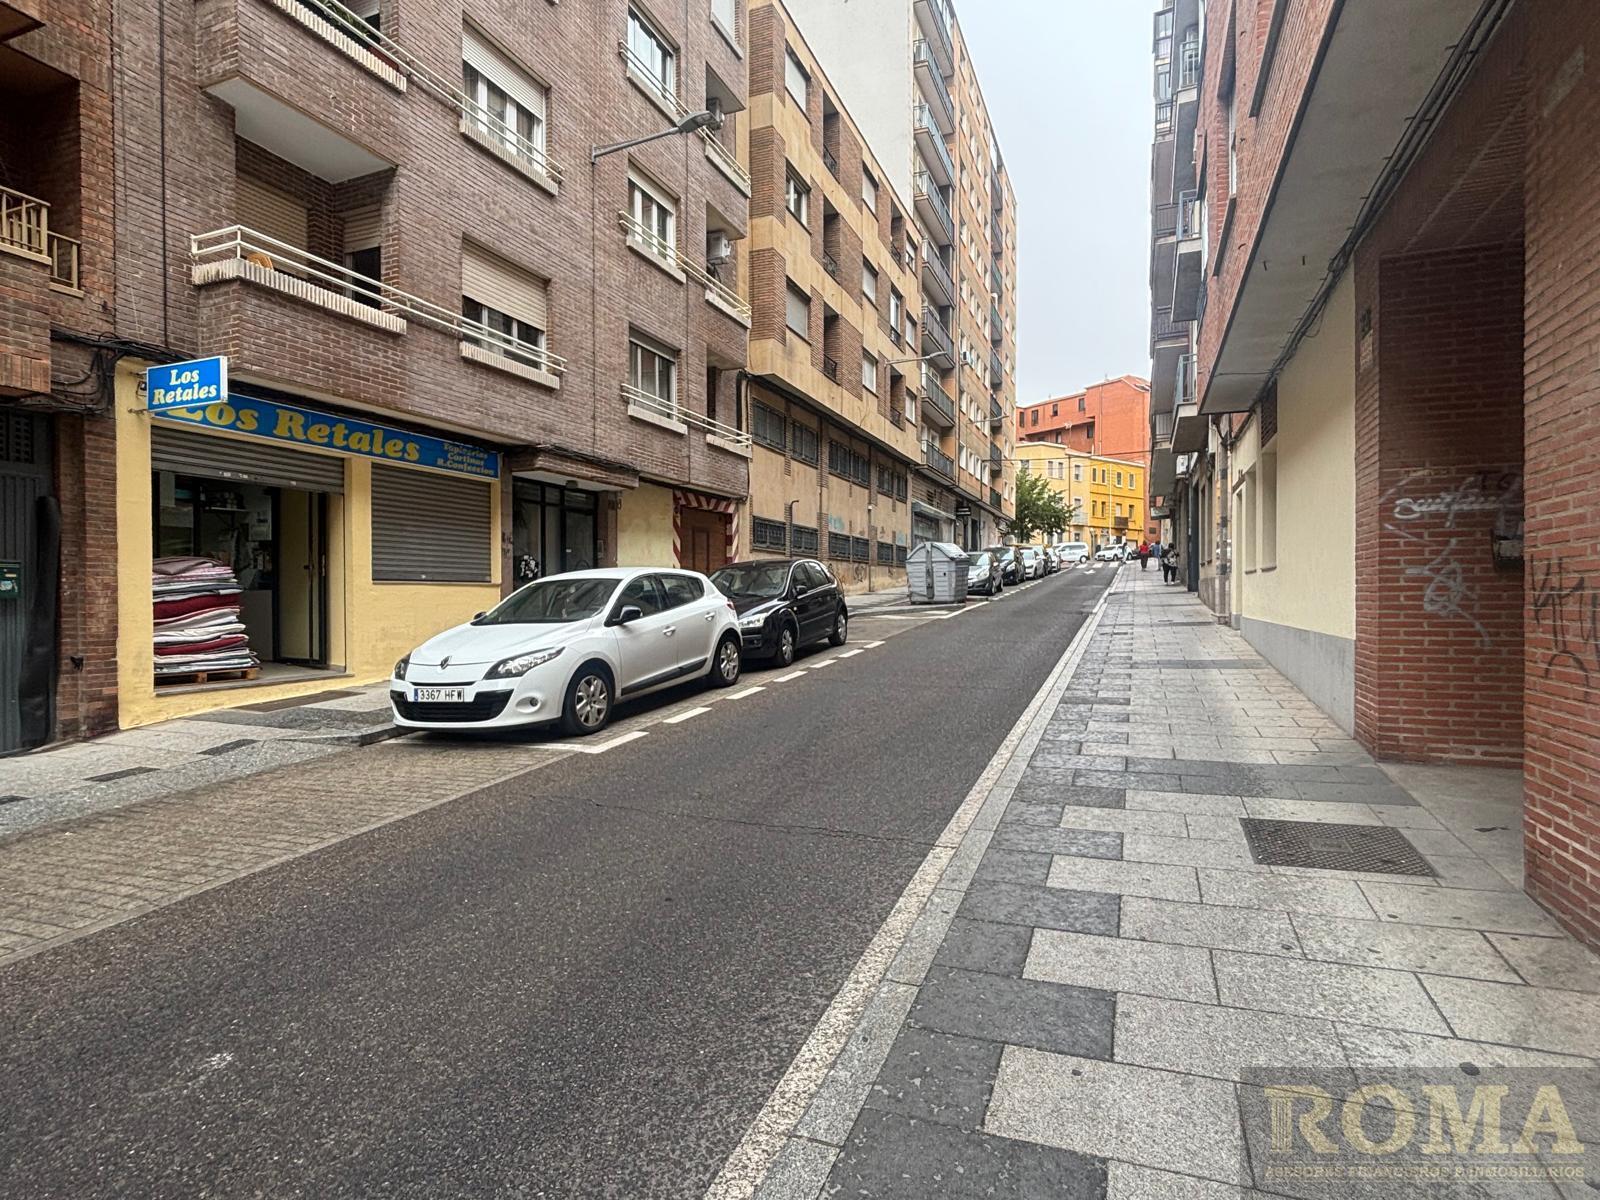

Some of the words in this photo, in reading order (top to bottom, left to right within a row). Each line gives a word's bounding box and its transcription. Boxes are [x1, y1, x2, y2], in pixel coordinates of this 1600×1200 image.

[169, 369, 199, 386] Los
[152, 383, 218, 405] Retales
[273, 408, 420, 462] Retales
[420, 689, 441, 701] 3367
[444, 689, 463, 701] HFW
